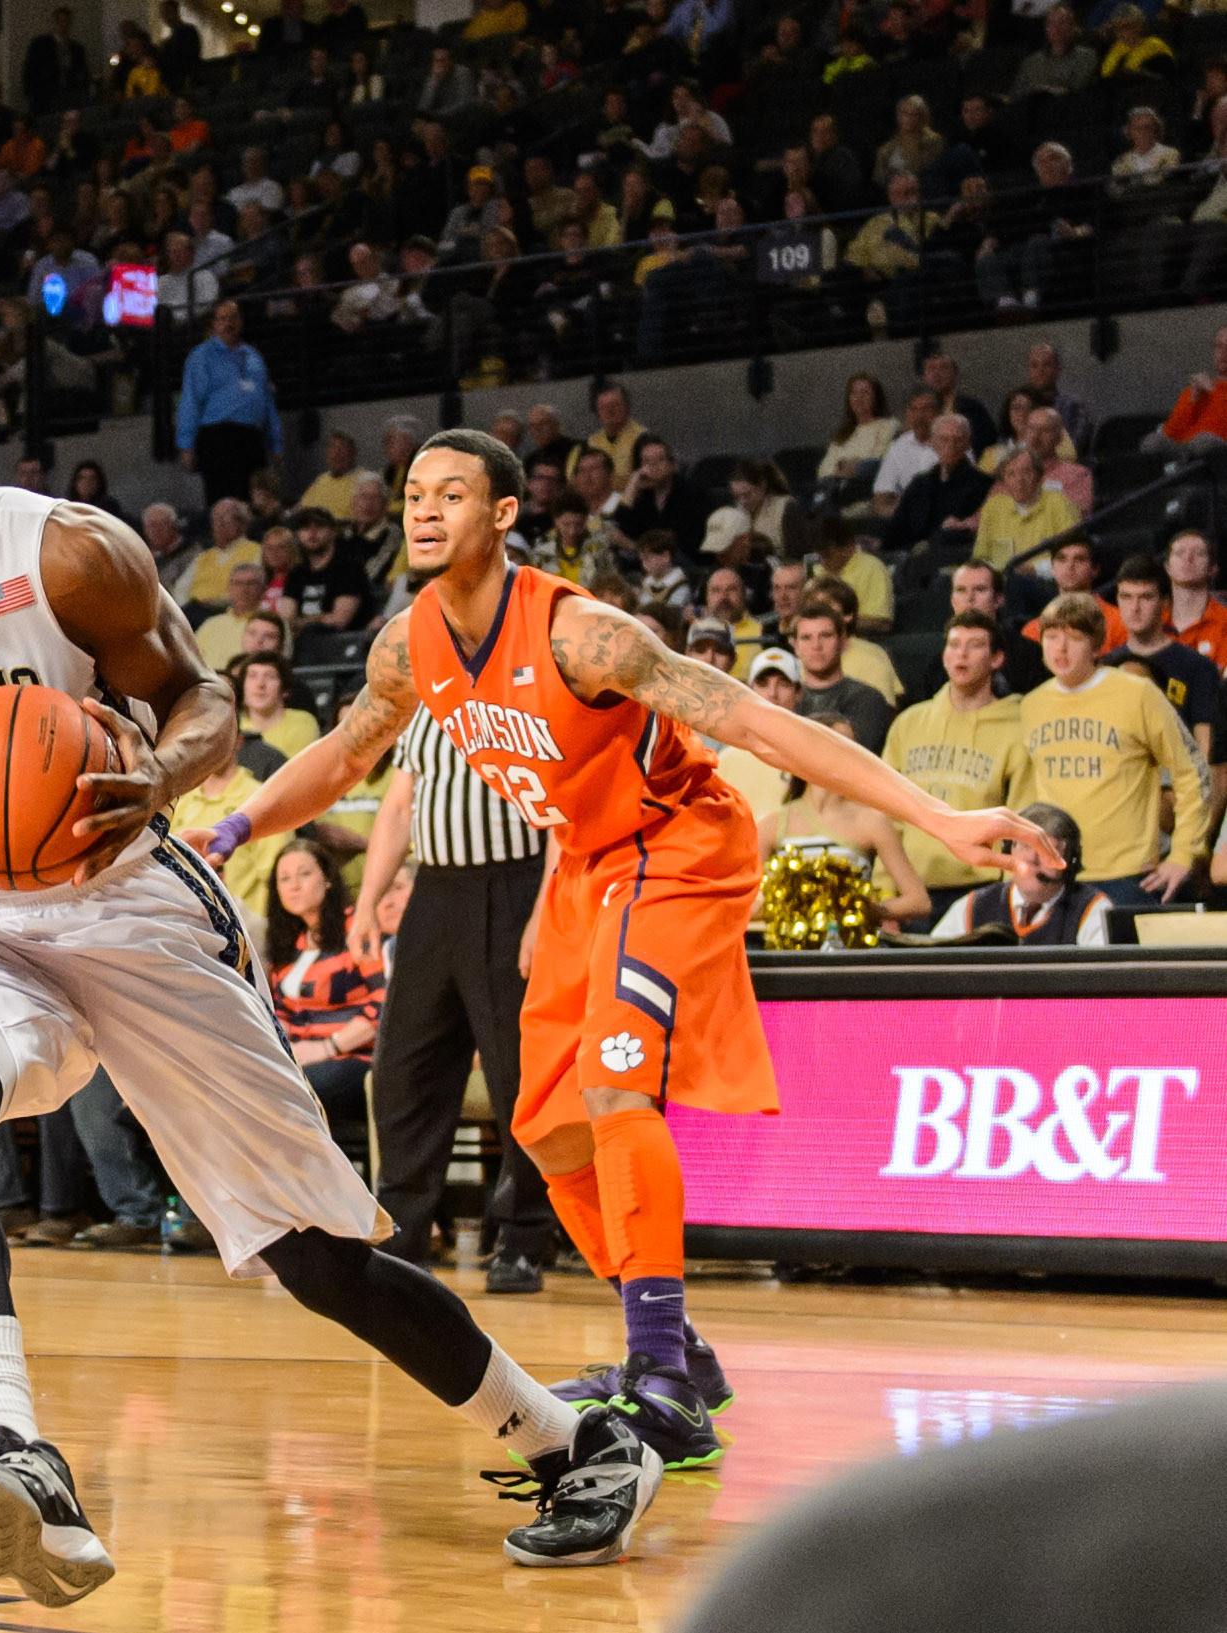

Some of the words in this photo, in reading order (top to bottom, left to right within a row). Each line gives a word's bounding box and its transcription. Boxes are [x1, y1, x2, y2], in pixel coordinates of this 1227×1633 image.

[769, 244, 810, 270] 109
[442, 698, 566, 762] CLEMSON
[1029, 716, 1122, 756] GEORGIA
[1043, 755, 1103, 779] TECH
[878, 1064, 1200, 1183] BB&T
